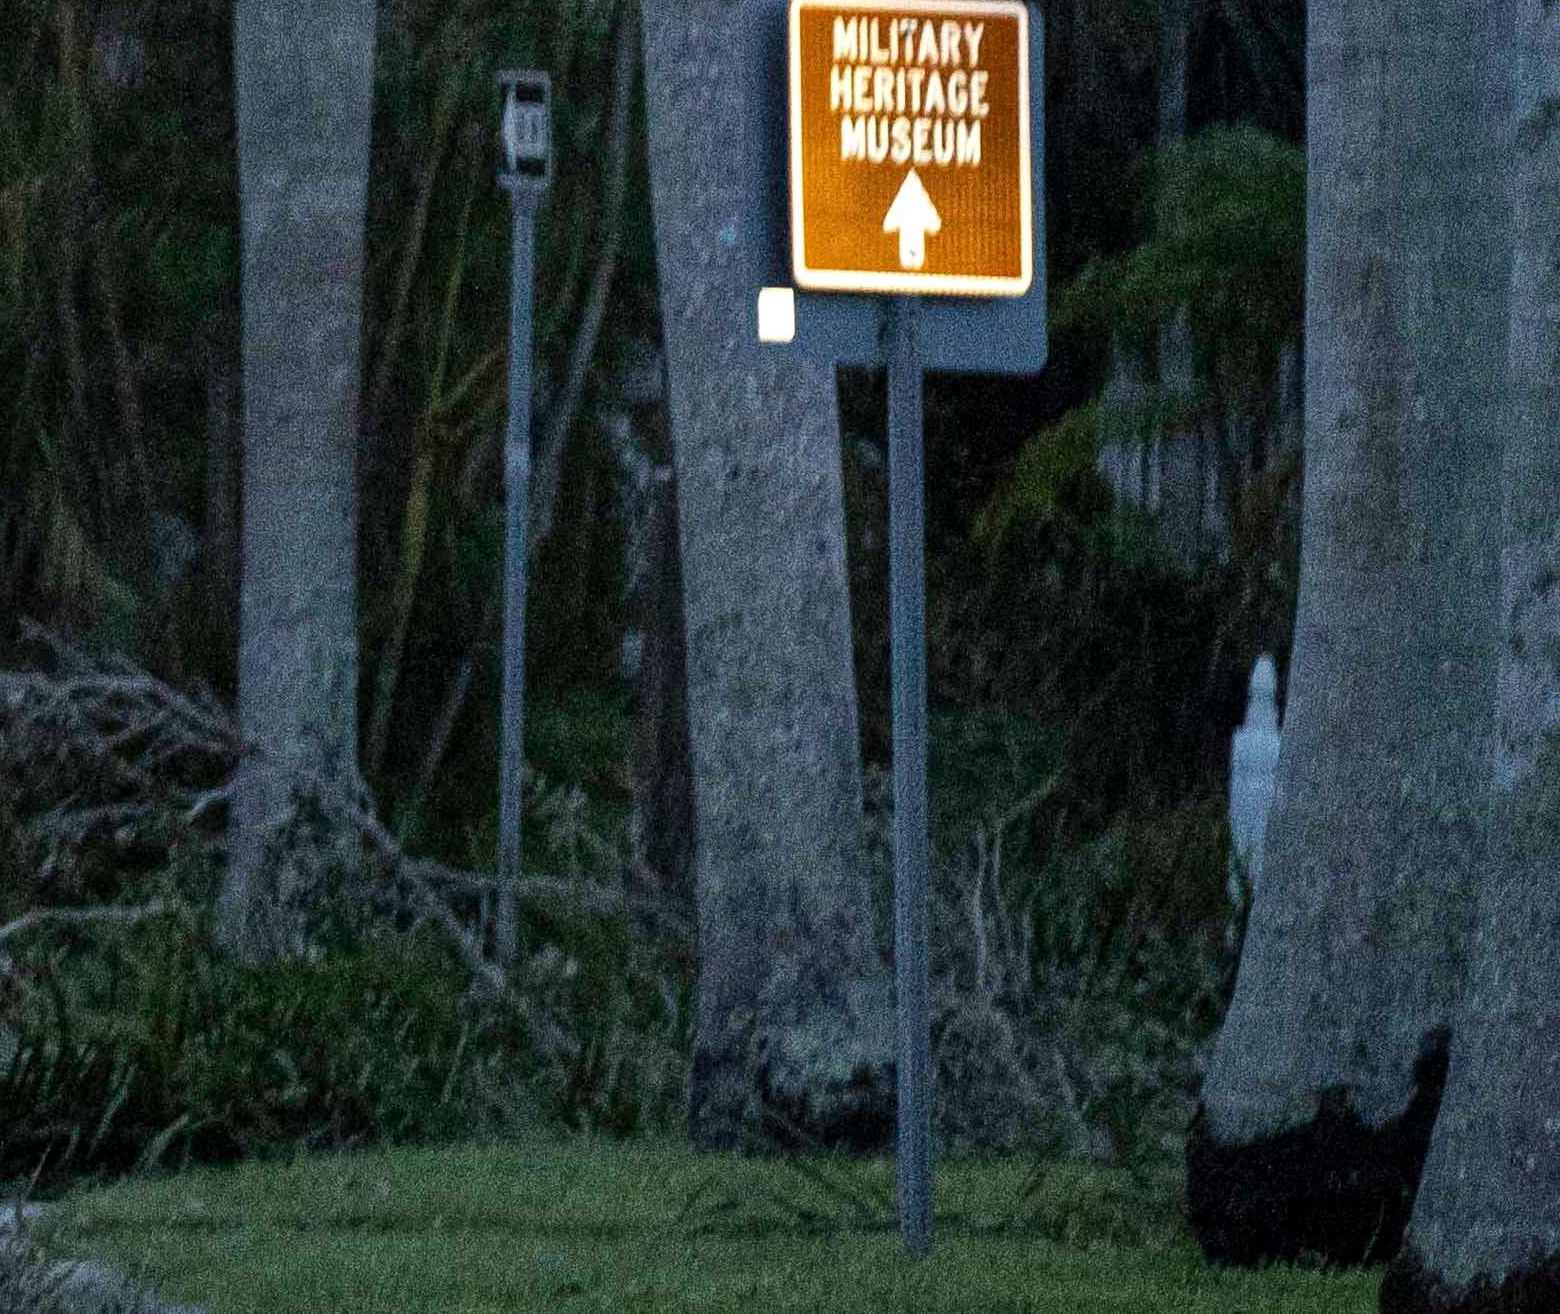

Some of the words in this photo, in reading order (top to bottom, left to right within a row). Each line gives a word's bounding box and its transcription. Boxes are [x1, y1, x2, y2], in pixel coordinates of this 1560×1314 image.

[831, 16, 984, 66] MILITARY
[829, 65, 990, 118] HERITAGE
[839, 116, 982, 167] MUSEUM
